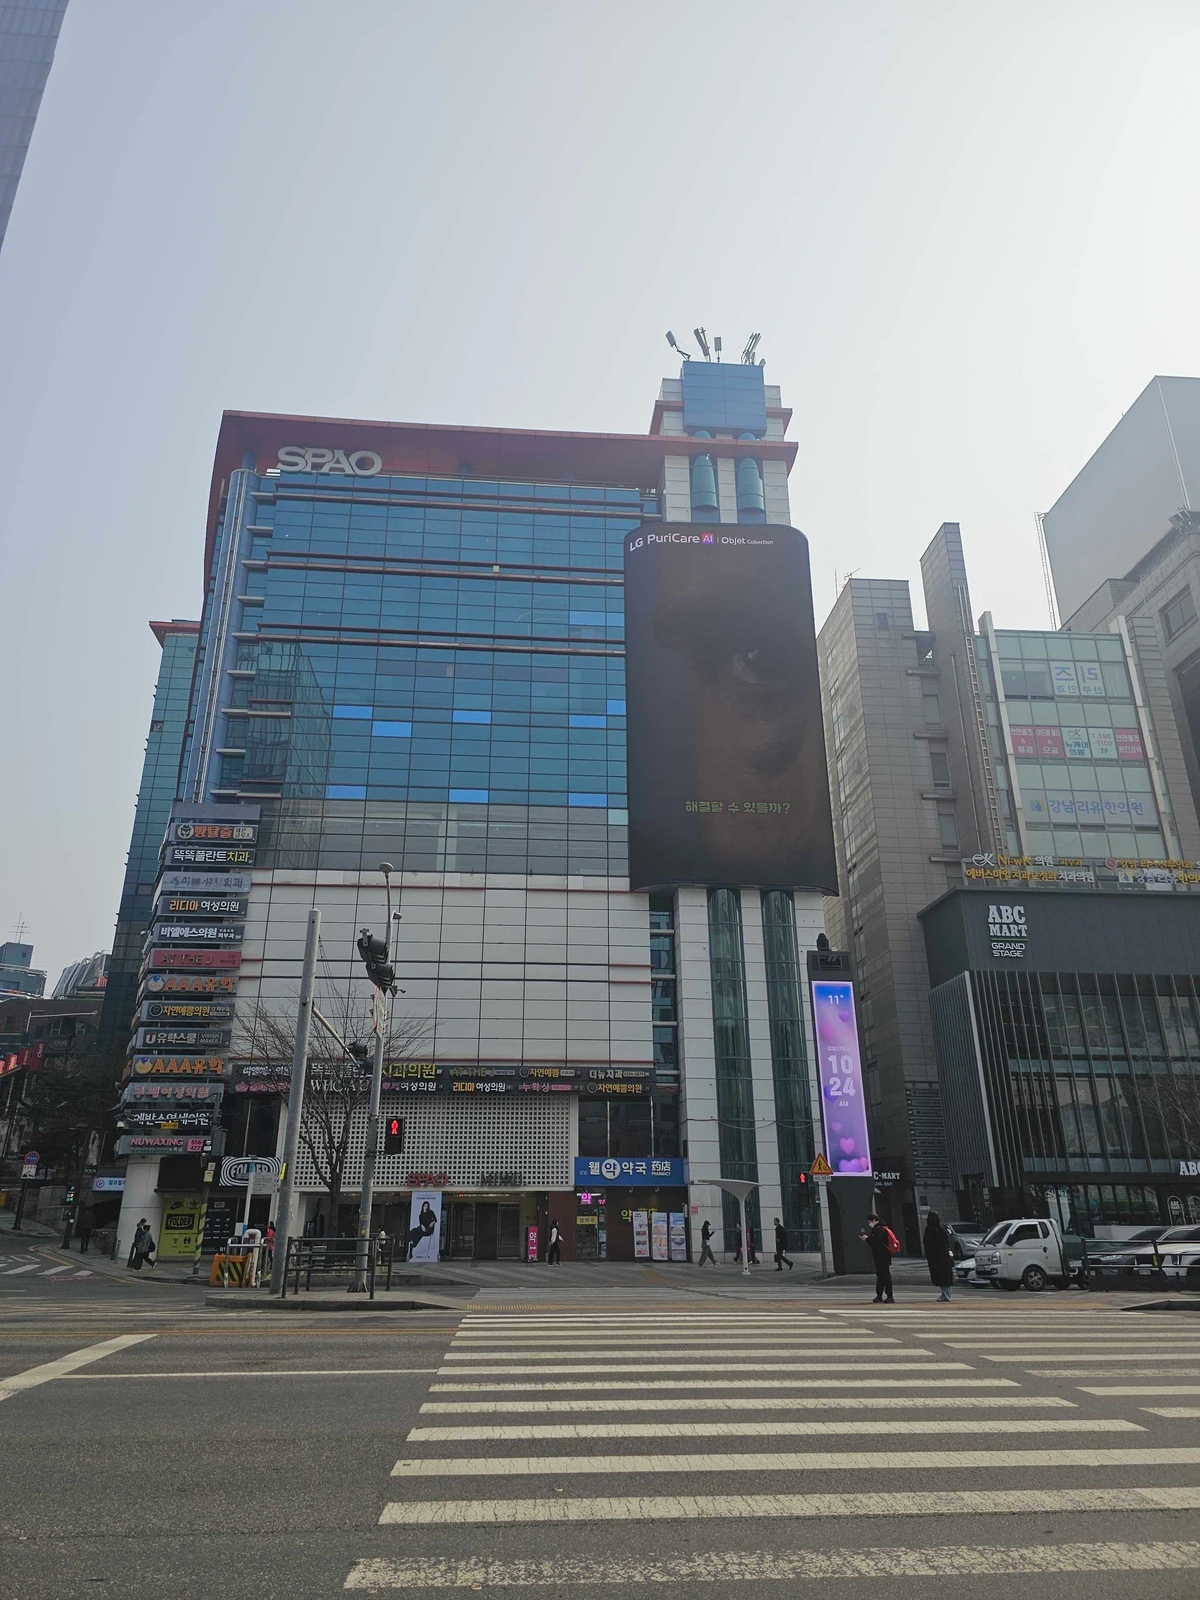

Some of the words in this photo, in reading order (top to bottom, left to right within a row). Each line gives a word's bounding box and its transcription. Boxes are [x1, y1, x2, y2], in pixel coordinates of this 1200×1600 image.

[276, 446, 382, 475] SPAO
[630, 538, 643, 551] LG
[647, 534, 700, 544] PuriCare
[703, 535, 713, 543] AI
[721, 537, 746, 545] Objet
[685, 800, 723, 812] 해결할
[728, 802, 740, 813] 수
[743, 802, 791, 814] 있을까?
[1050, 800, 1144, 815] 강남리유한의원
[1035, 856, 1053, 866] 의원
[169, 900, 199, 911] 리디아
[201, 901, 239, 912] 여성의원
[987, 905, 1026, 924] ABC
[160, 927, 218, 938] 비엘에스의원
[989, 924, 1028, 937] MART
[161, 954, 176, 964] AT
[180, 954, 202, 964] THE
[206, 954, 214, 964] J
[163, 976, 236, 992] AAA유학
[828, 994, 844, 1005] 11°
[157, 1032, 197, 1044] 유학스쿨
[151, 1058, 225, 1075] AAA유학
[828, 1054, 854, 1074] 10
[452, 1082, 474, 1092] 리디아
[476, 1082, 506, 1092] 여성의원
[522, 1083, 550, 1092] 누왁싱
[829, 1077, 856, 1096] 24
[130, 1138, 184, 1146] NUWAXING
[231, 1164, 269, 1177] FOLER
[588, 1162, 600, 1176] 웰
[604, 1162, 618, 1176] 약
[622, 1161, 647, 1176] 약국
[652, 1160, 671, 1172] 药店
[1179, 1161, 1200, 1176] AB
[407, 1172, 449, 1187] SPAO
[581, 1192, 592, 1204] 약
[168, 1216, 194, 1227] FOLDER
